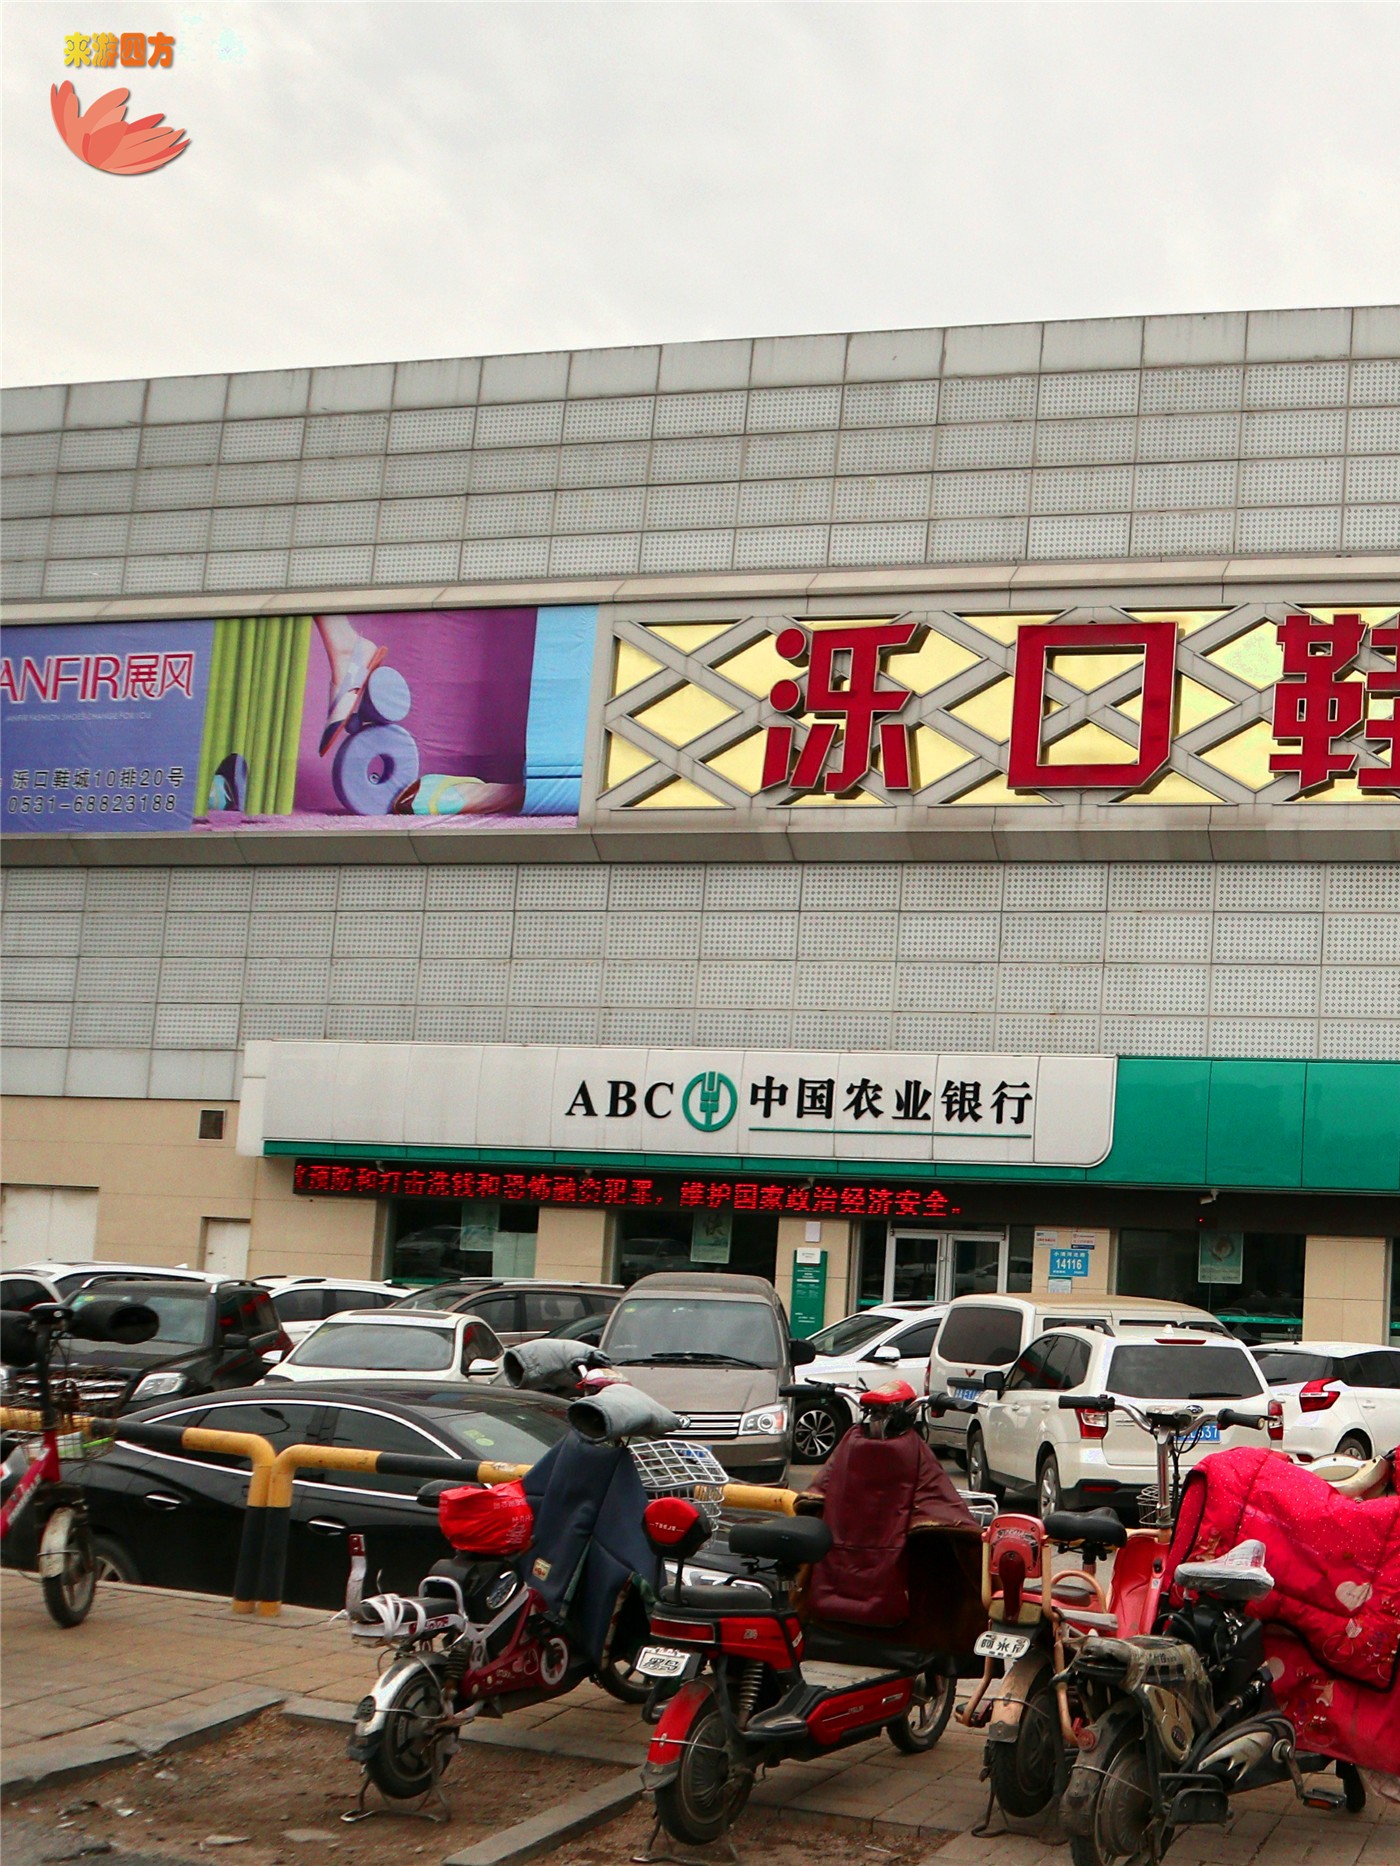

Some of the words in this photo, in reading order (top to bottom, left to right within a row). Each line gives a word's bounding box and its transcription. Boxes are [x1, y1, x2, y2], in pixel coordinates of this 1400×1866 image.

[12, 767, 184, 790] 泺口鞋城10排20号
[565, 1080, 675, 1118] ABC
[749, 1076, 1033, 1125] 中国农业银行
[1056, 1259, 1082, 1269] 14116
